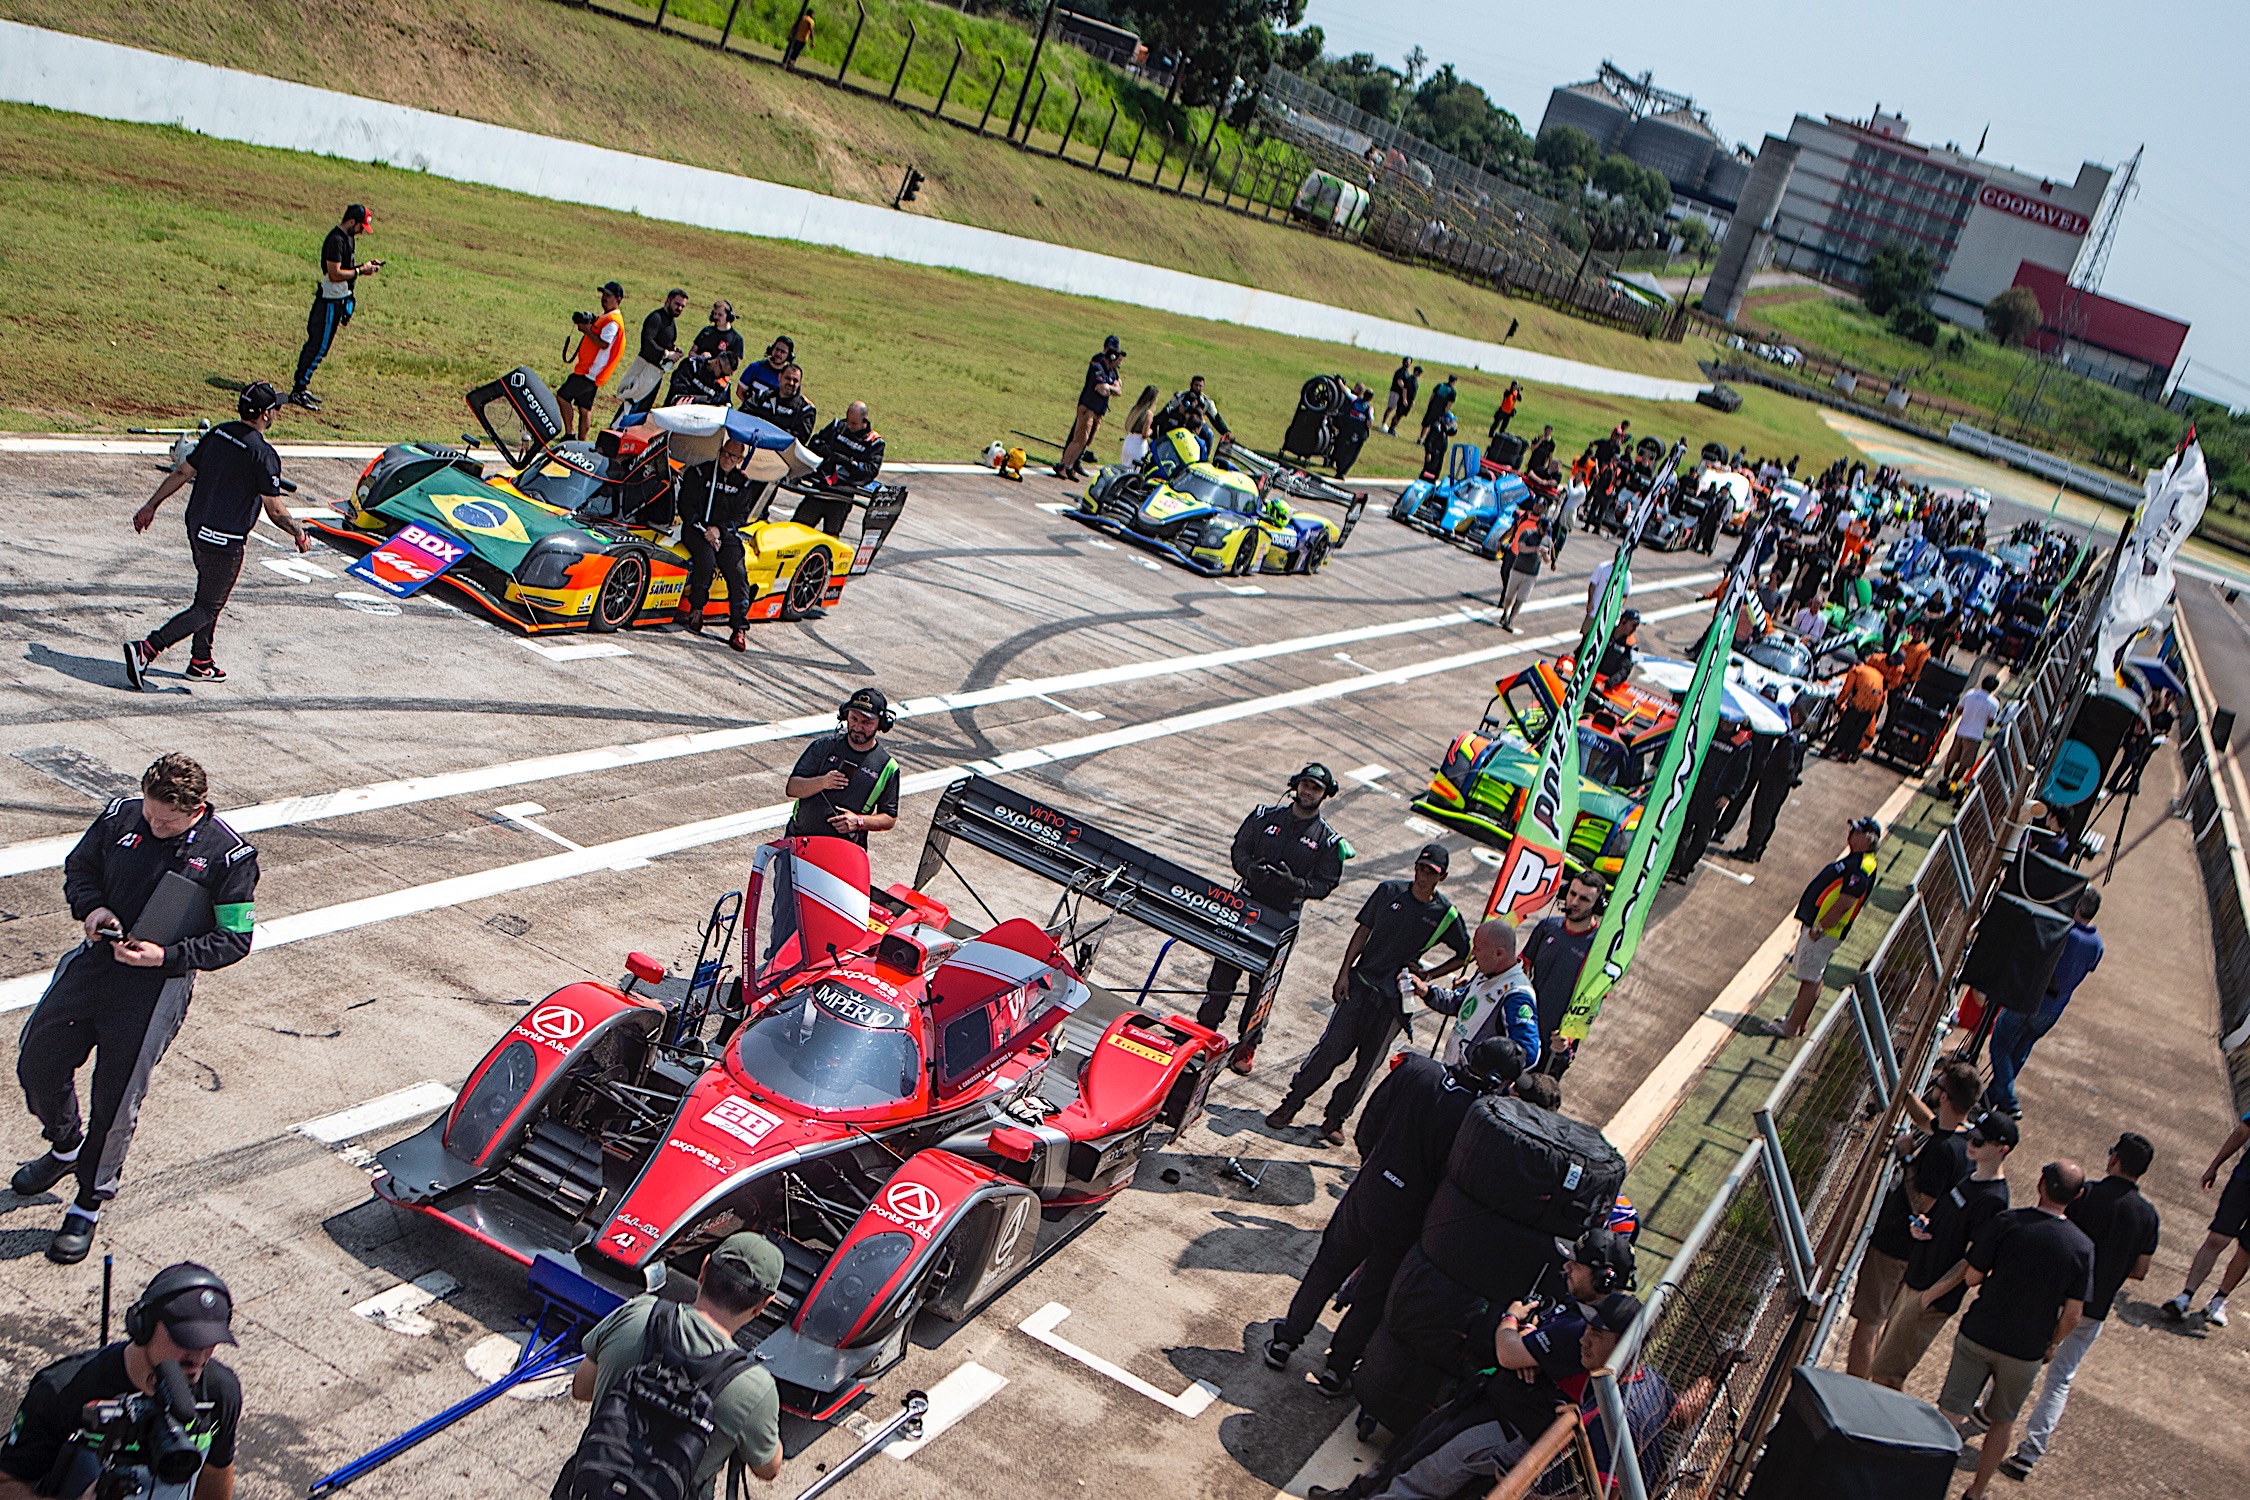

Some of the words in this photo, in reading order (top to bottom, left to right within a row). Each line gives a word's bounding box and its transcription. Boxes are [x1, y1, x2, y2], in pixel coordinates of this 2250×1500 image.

[1983, 188, 2086, 234] COOPAVEL
[522, 387, 557, 435] segware
[398, 524, 464, 563] BOX
[371, 551, 434, 580] 444
[649, 584, 673, 596] SANTA
[994, 805, 1062, 841] express
[1029, 804, 1065, 828] vinho
[1170, 884, 1241, 923] express
[1207, 884, 1245, 910] vinho
[829, 968, 899, 999] express
[873, 987, 894, 1003] .com
[511, 1025, 546, 1043] Ponte
[544, 1039, 572, 1056] Alta
[1115, 1038, 1166, 1062] PIRELLI
[711, 1100, 775, 1138] 28
[668, 1138, 721, 1166] express
[867, 1203, 905, 1225] Ponte
[903, 1220, 932, 1241] Alta
